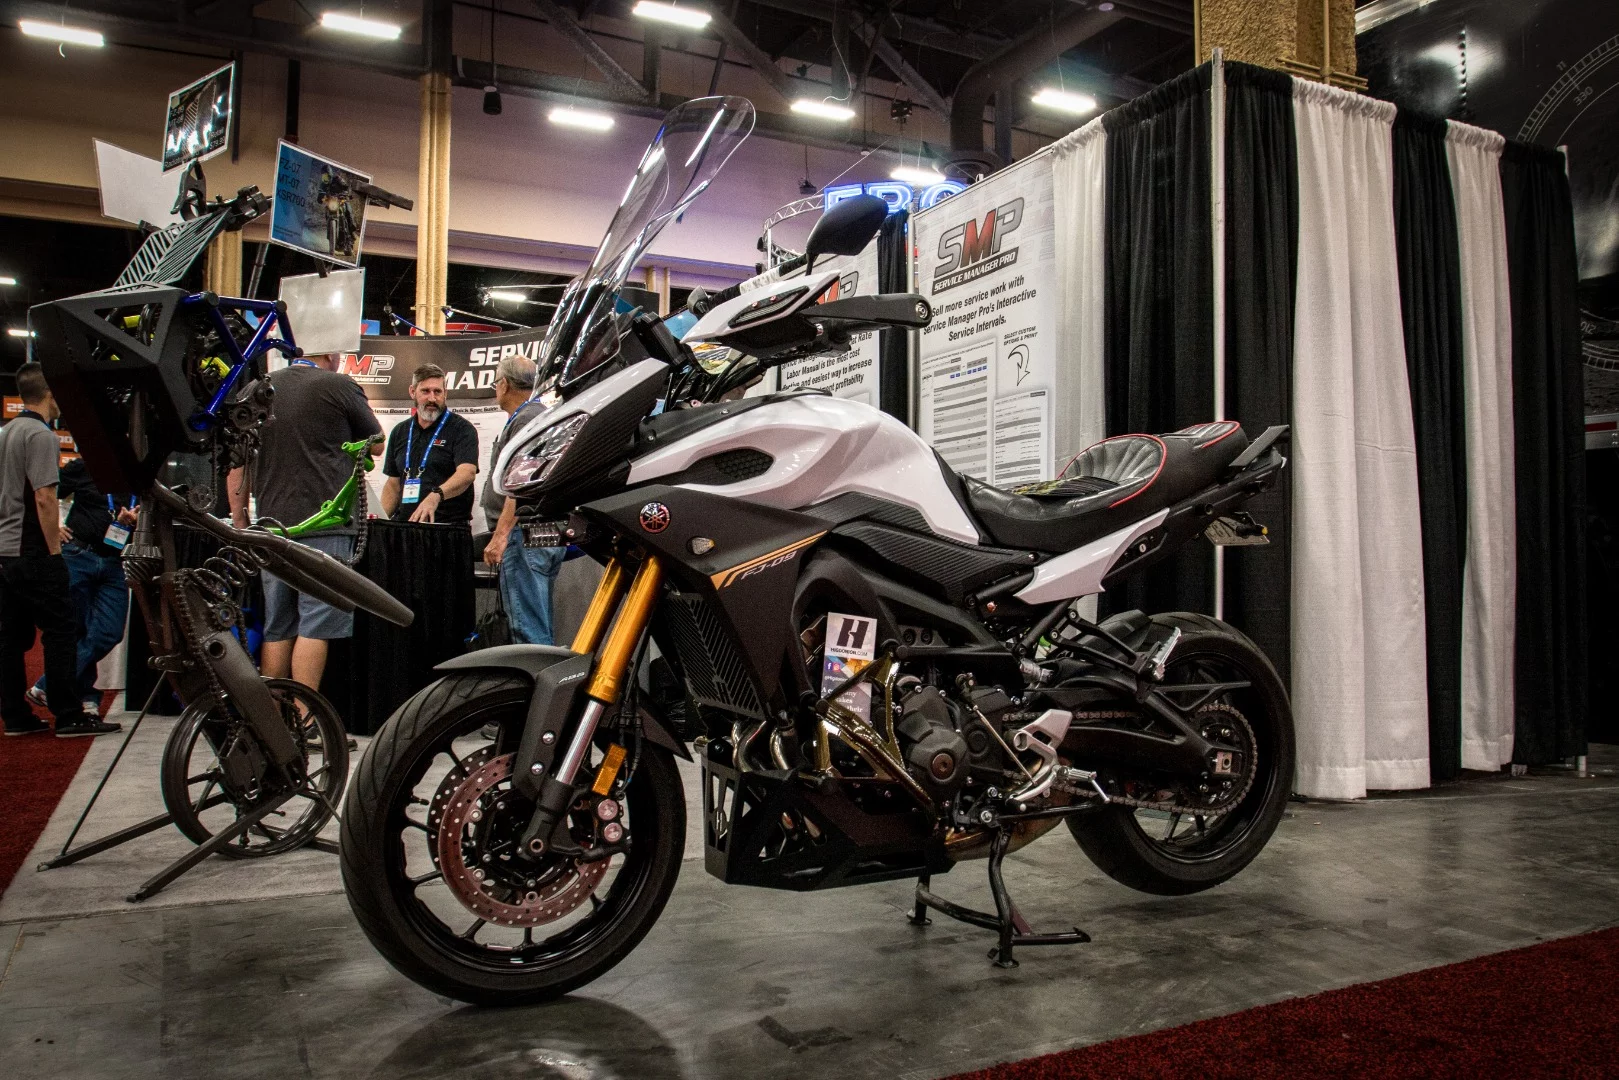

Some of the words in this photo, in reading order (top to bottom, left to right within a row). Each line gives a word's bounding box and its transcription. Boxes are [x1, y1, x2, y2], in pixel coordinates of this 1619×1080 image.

[1574, 86, 1593, 106] 330
[934, 196, 1025, 278] SMP
[934, 273, 963, 292] SERVICE
[962, 259, 998, 280] MANAGER
[999, 251, 1016, 267] PRO
[931, 304, 944, 318] Sell
[945, 301, 963, 314] more
[964, 290, 989, 307] service
[990, 281, 1006, 298] work
[1008, 274, 1025, 290] with
[948, 310, 978, 328] Manager
[978, 302, 995, 317] Pro's
[997, 288, 1037, 311] Interactive
[948, 326, 975, 342] Service
[975, 314, 1007, 334] Intervals.
[786, 369, 801, 380] Labor
[802, 361, 821, 375] Manual
[821, 360, 826, 369] is
[827, 358, 836, 368] the
[849, 347, 861, 359] cost
[801, 377, 811, 387] and
[812, 372, 830, 385] easiest
[831, 370, 842, 379] way
[842, 367, 848, 375] to
[849, 359, 873, 373] increase
[835, 374, 865, 392] profitability
[741, 550, 797, 580] FJ-09
